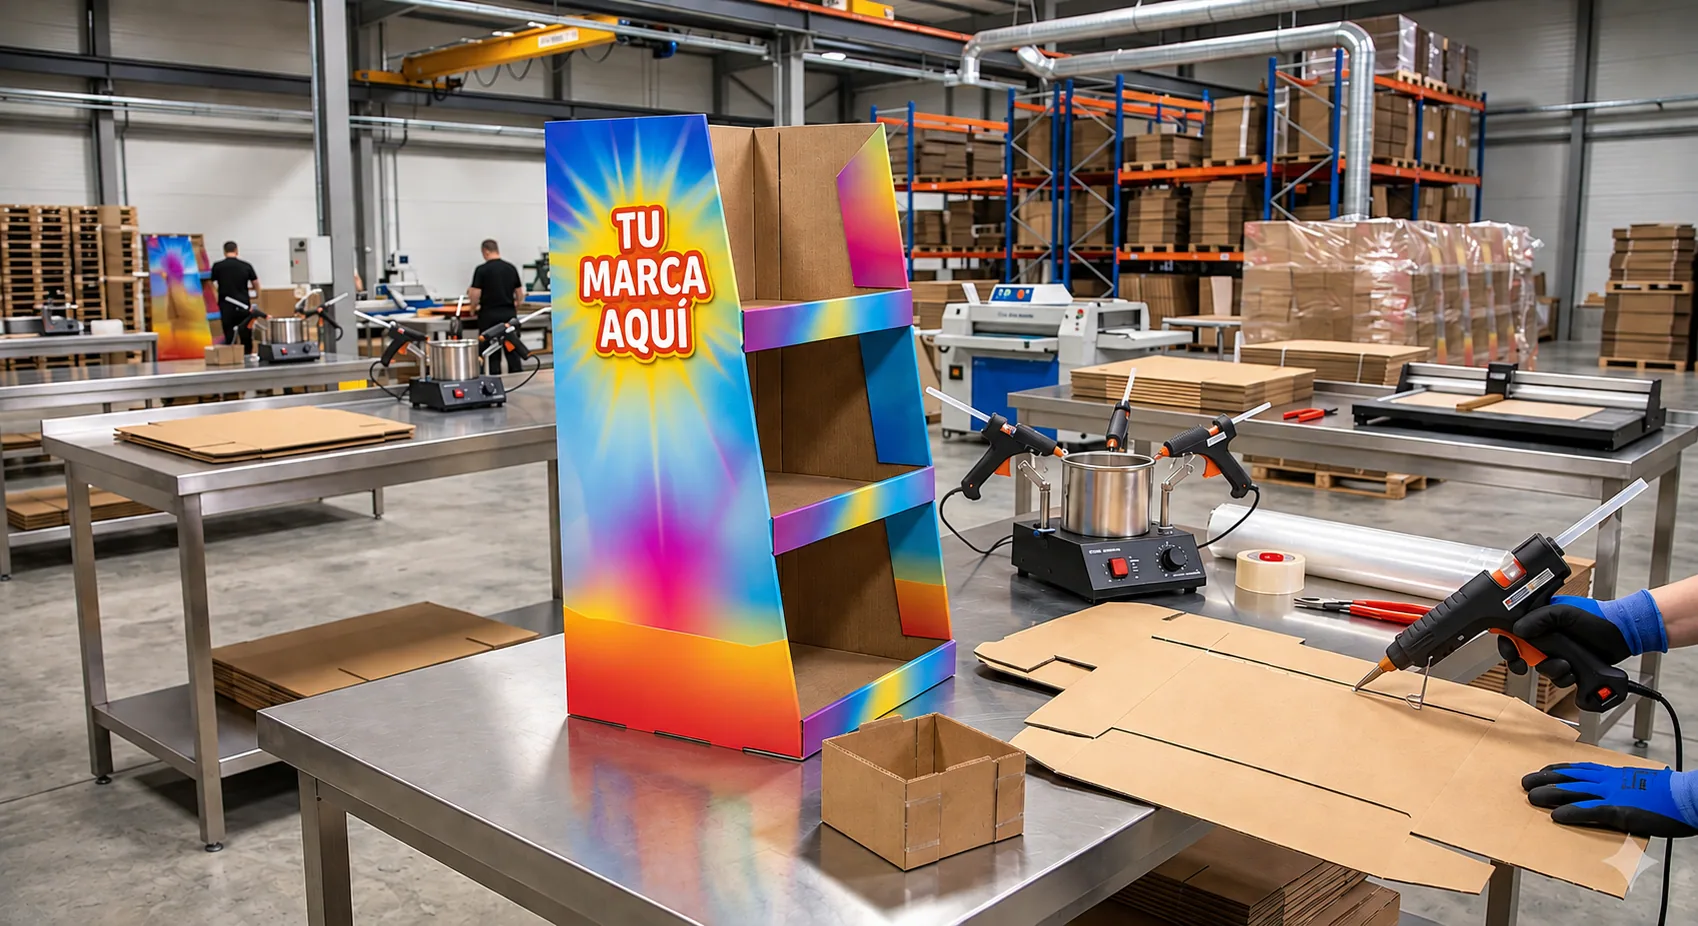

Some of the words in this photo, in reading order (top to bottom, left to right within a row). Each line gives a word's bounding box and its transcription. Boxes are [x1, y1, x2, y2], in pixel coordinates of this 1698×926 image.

[616, 210, 660, 250] TU
[583, 255, 707, 298] MARCA
[600, 297, 688, 354] AQUÍ
